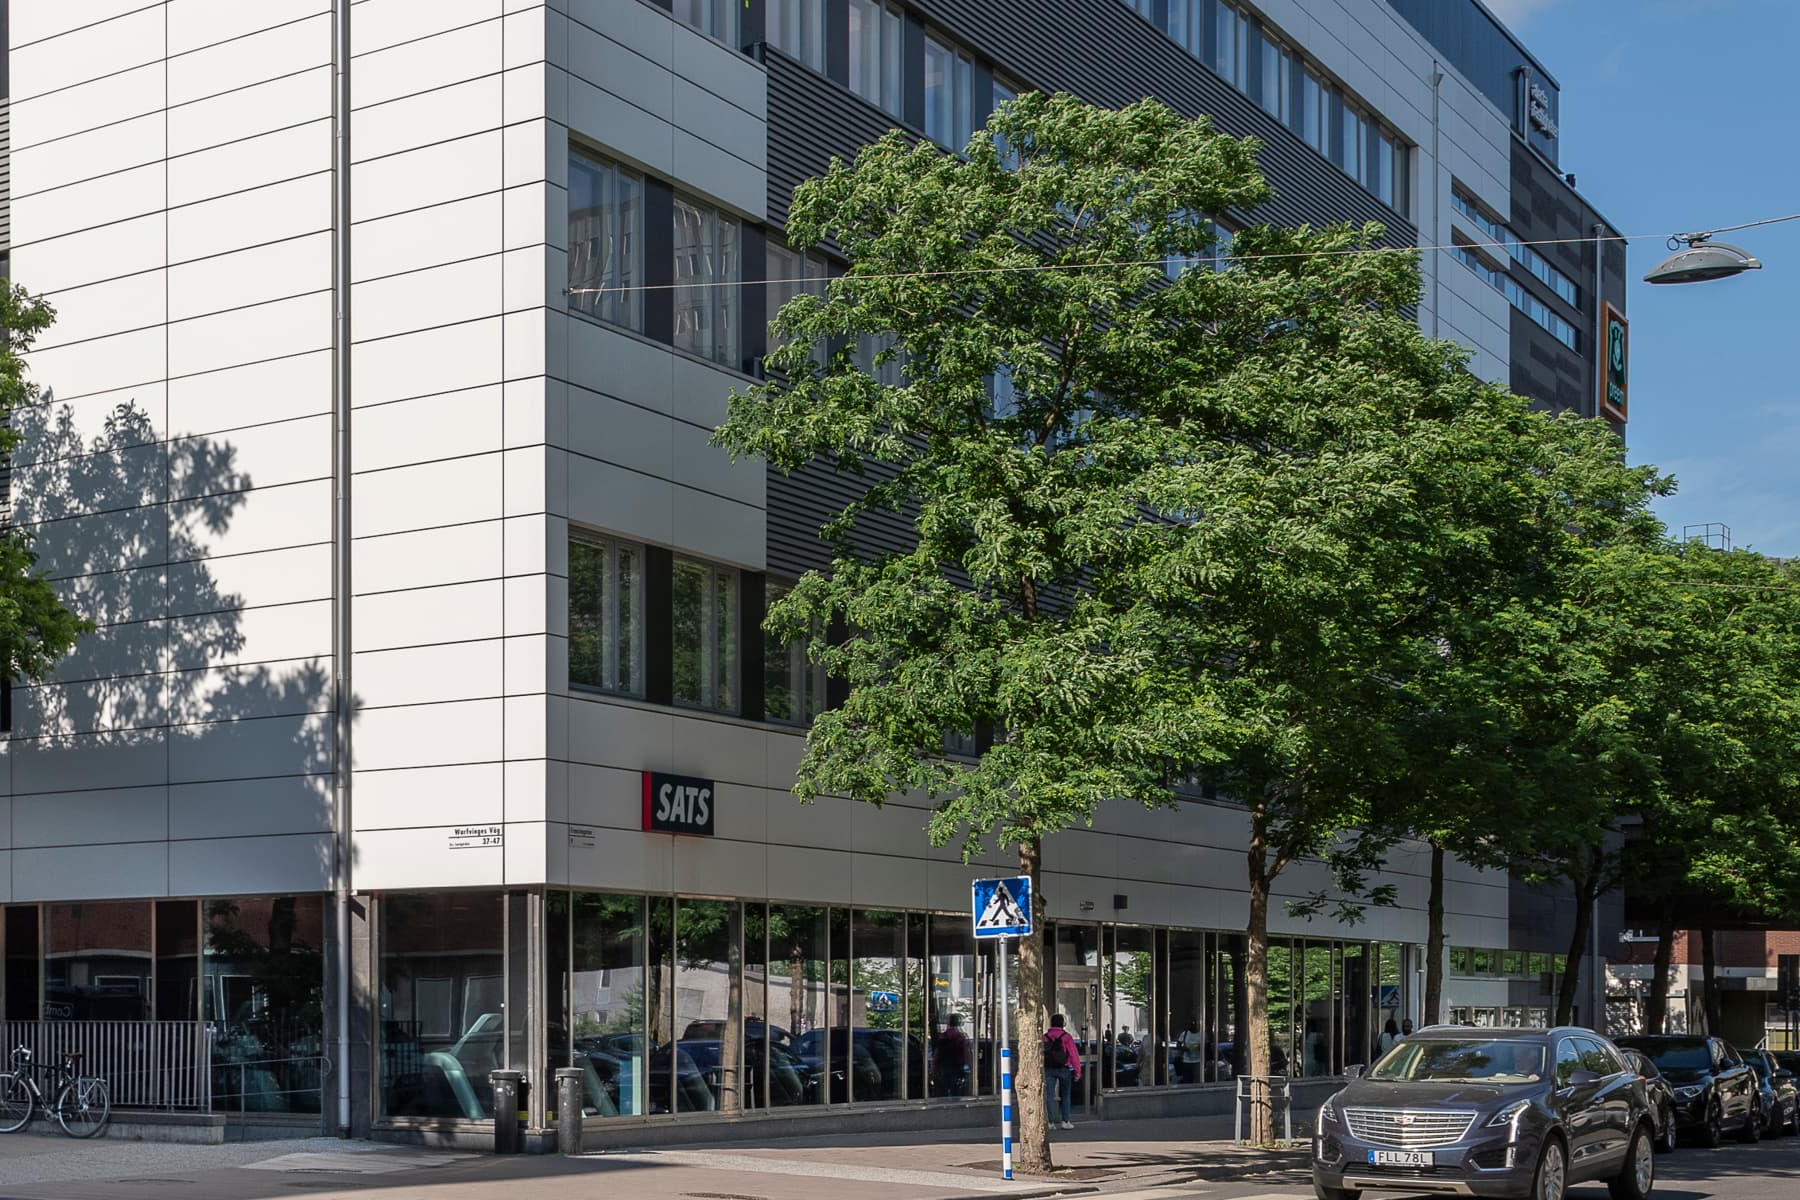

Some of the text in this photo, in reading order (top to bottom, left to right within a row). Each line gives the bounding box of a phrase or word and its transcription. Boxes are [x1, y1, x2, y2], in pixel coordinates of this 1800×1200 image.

[656, 783, 711, 825] SATS
[1090, 985, 1097, 1000] 9
[1378, 1151, 1427, 1164] FLL 78L
